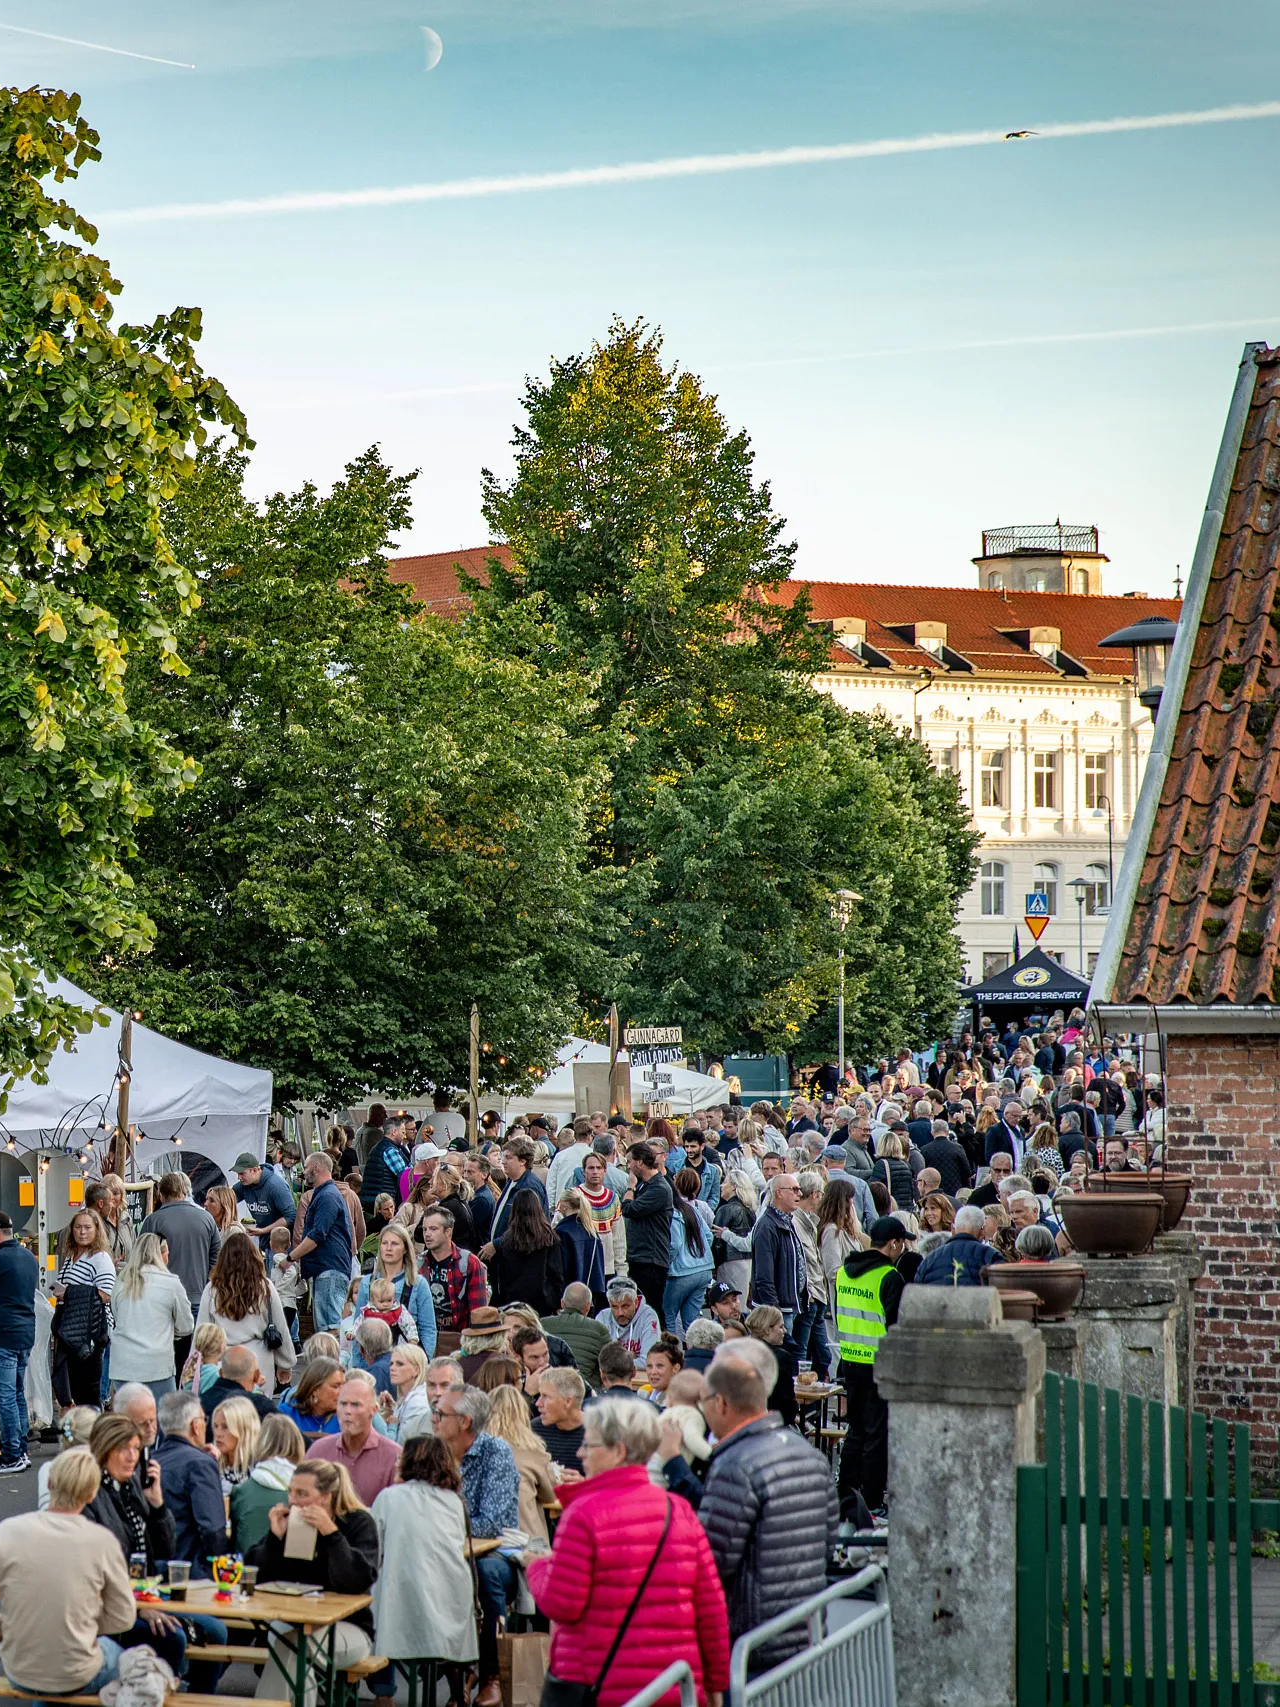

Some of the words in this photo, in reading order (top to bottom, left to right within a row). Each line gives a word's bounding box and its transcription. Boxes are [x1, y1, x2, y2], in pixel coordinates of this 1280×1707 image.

[976, 992, 992, 1000] THE
[993, 992, 1013, 1000] PINE
[1013, 992, 1041, 1000] RIDGE
[1041, 991, 1082, 999] BREWERY
[651, 1102, 670, 1117] TACO
[838, 1285, 874, 1300] FUNKTIONÄR
